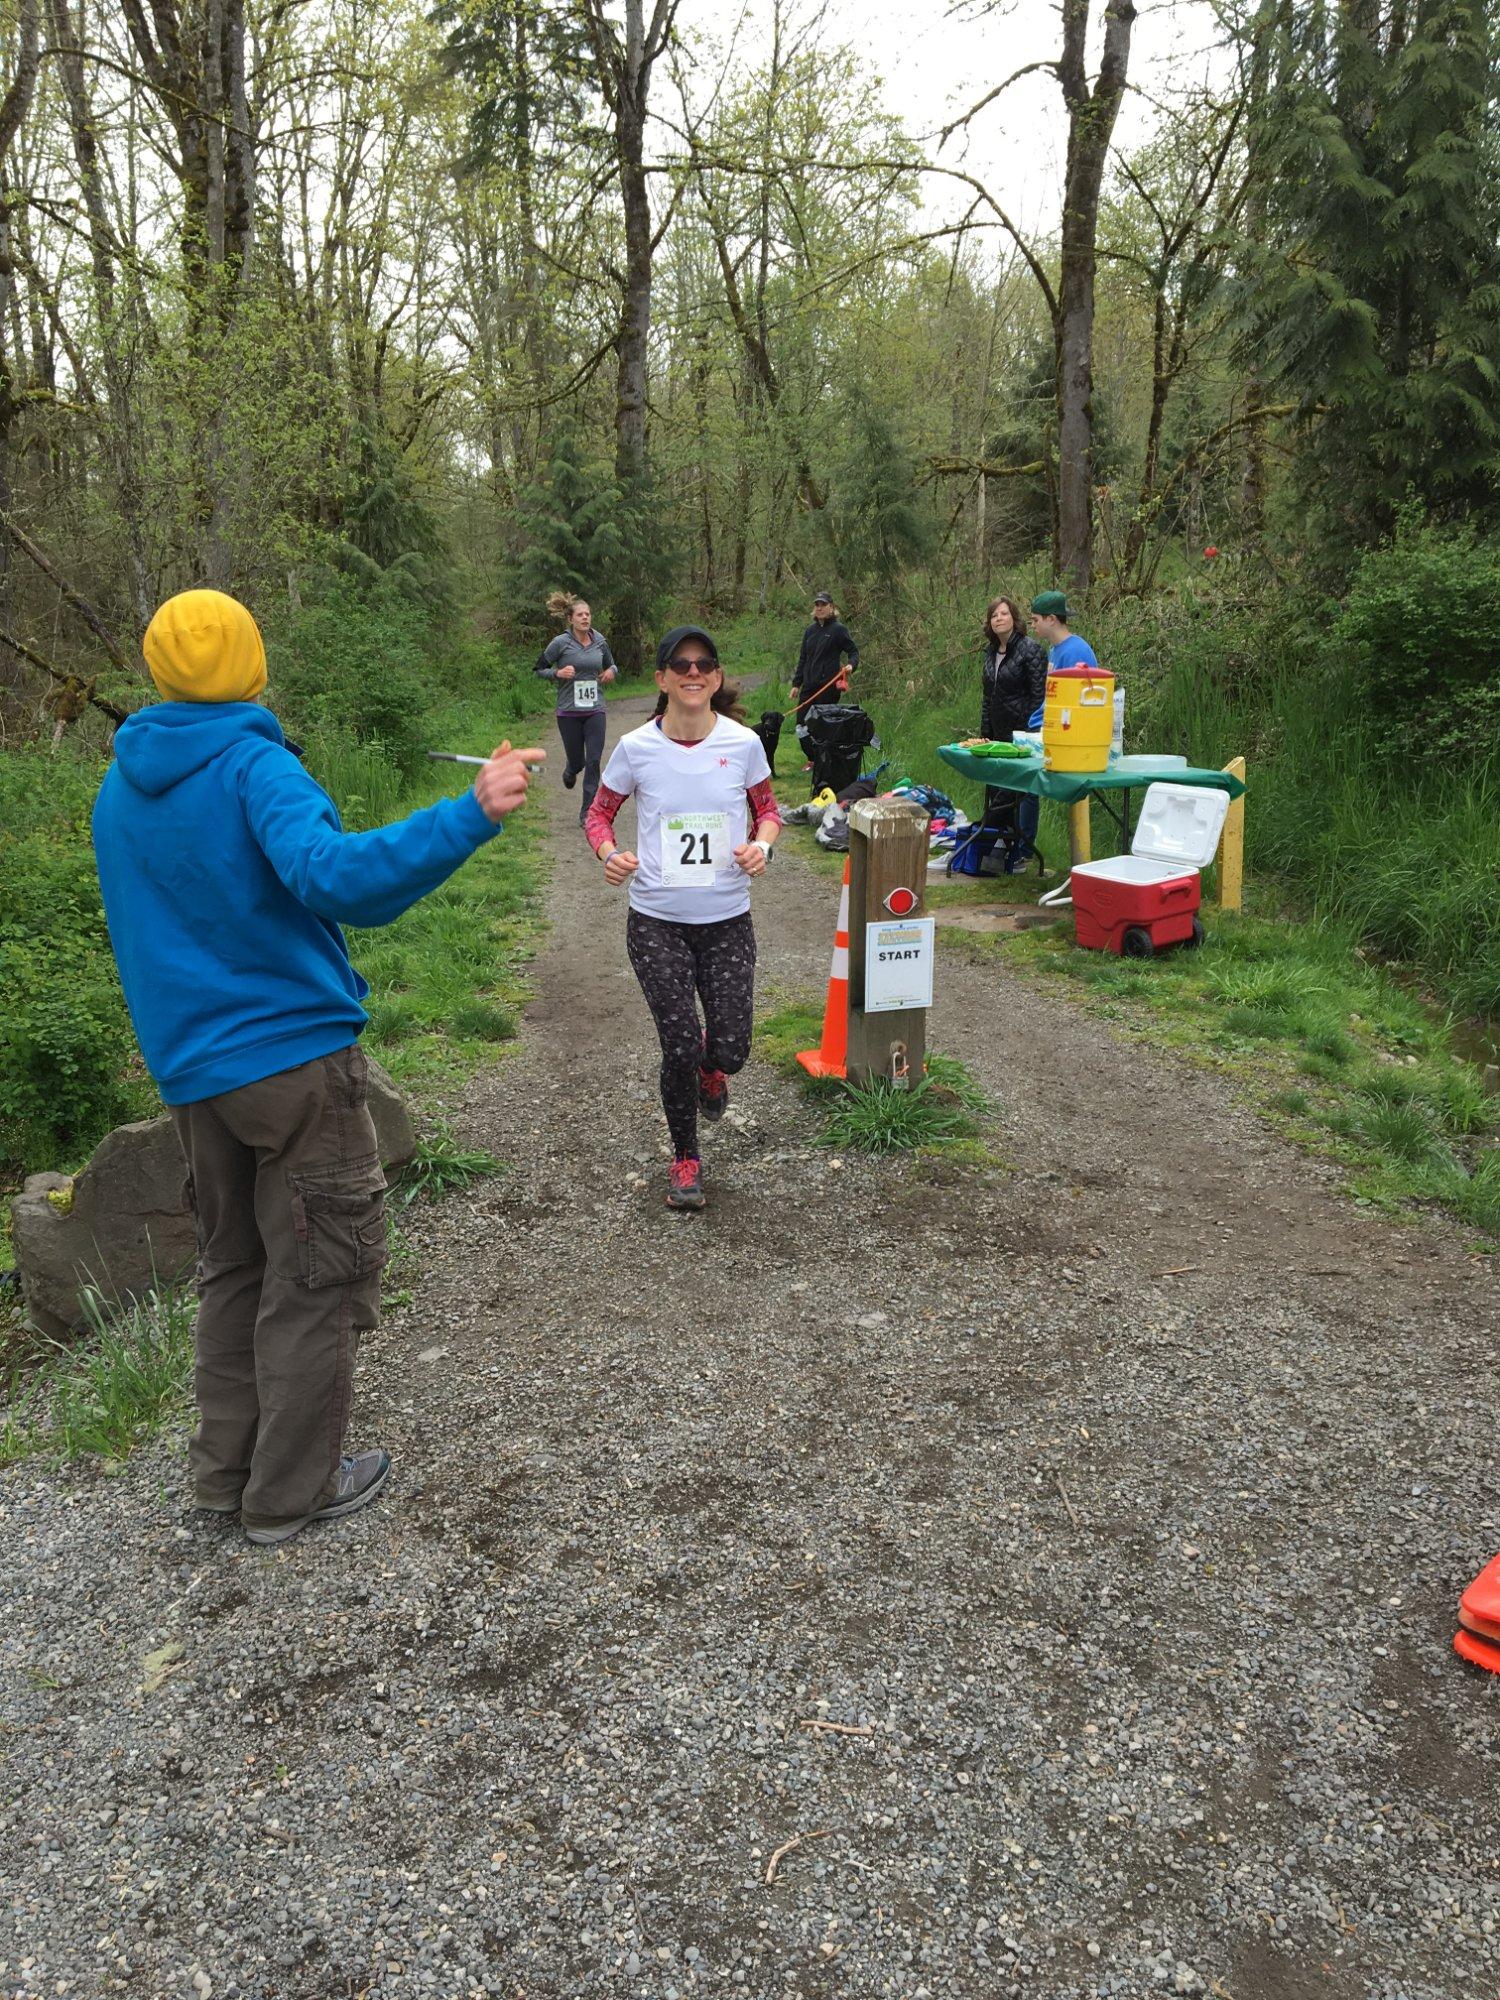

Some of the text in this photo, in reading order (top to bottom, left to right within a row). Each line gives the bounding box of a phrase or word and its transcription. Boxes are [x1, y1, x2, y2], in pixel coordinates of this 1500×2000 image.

[578, 687, 595, 700] 145
[684, 814, 725, 822] NORTHWEST
[680, 832, 712, 865] 21
[878, 949, 921, 962] START
